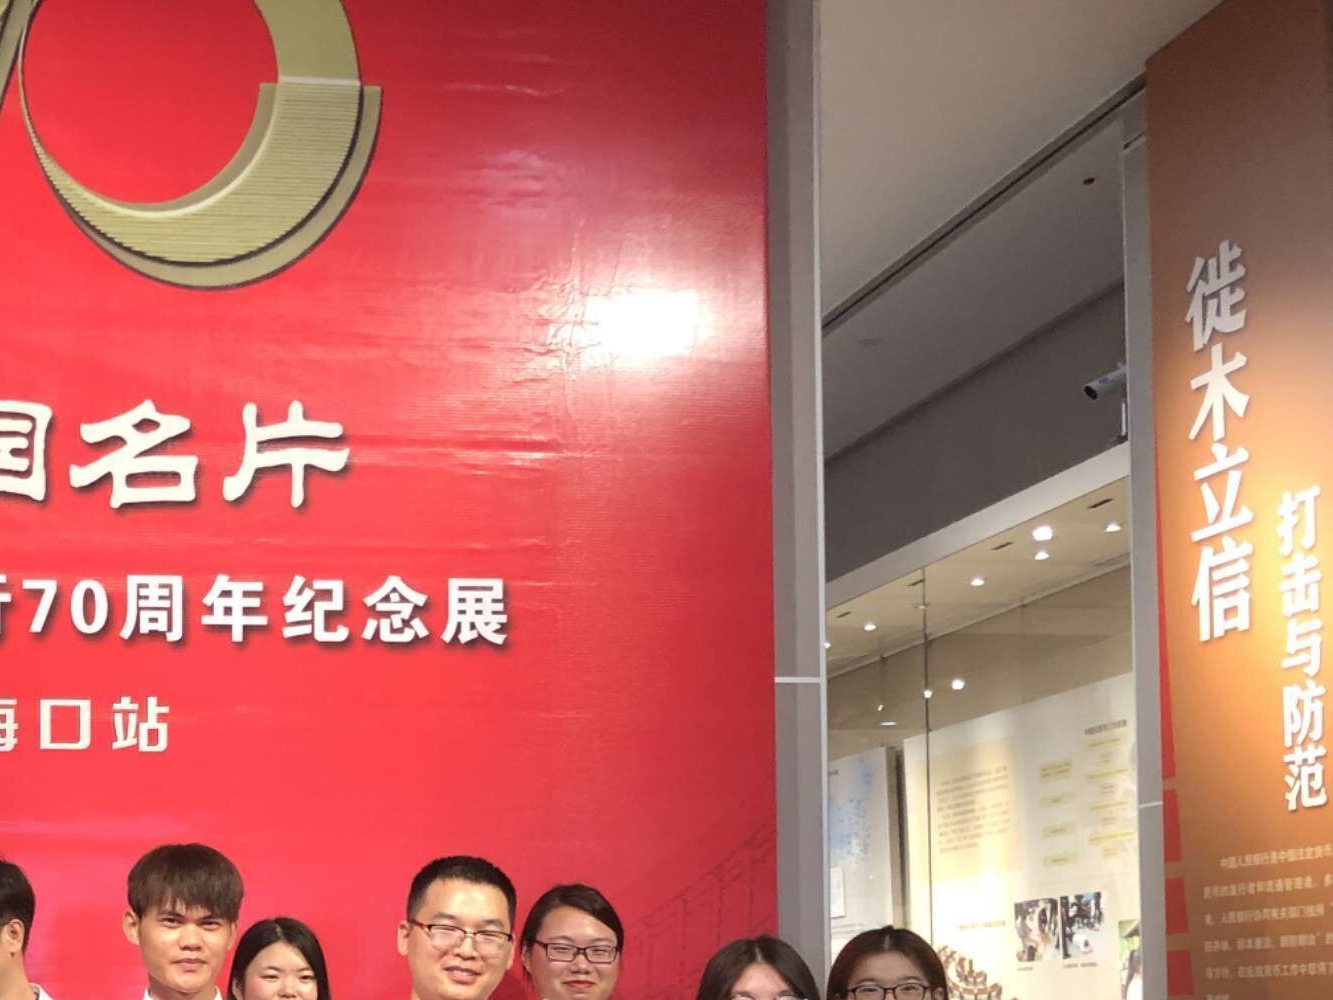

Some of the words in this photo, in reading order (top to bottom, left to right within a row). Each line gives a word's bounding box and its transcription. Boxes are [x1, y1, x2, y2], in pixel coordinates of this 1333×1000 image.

[1185, 240, 1254, 642] 徙木立信
[1276, 485, 1327, 811] 打击与防范
